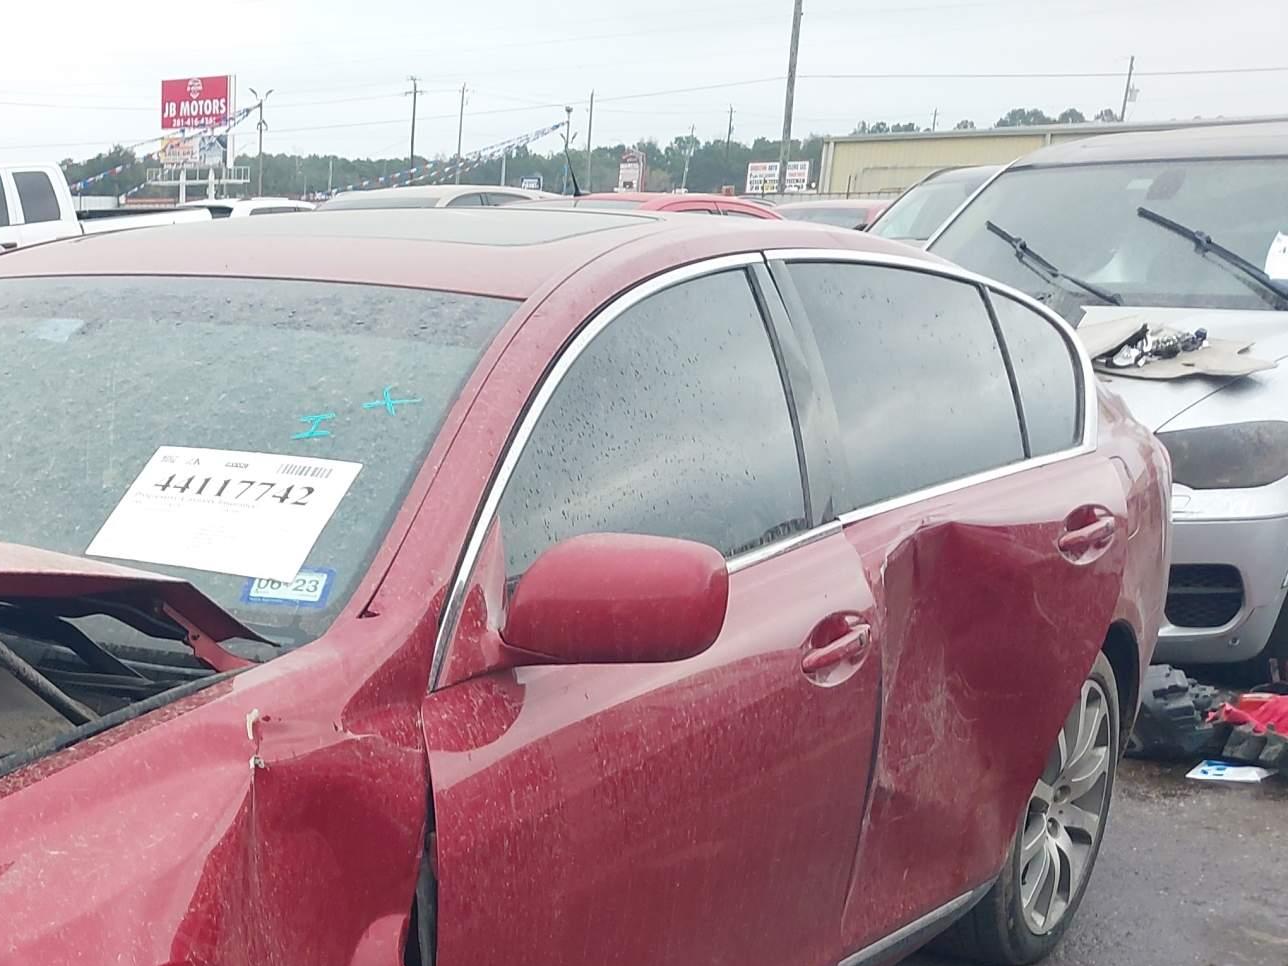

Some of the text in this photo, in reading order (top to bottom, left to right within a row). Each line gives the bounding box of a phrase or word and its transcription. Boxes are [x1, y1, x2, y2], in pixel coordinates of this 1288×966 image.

[164, 98, 226, 118] JB MOTORS
[154, 473, 316, 507] 44117742
